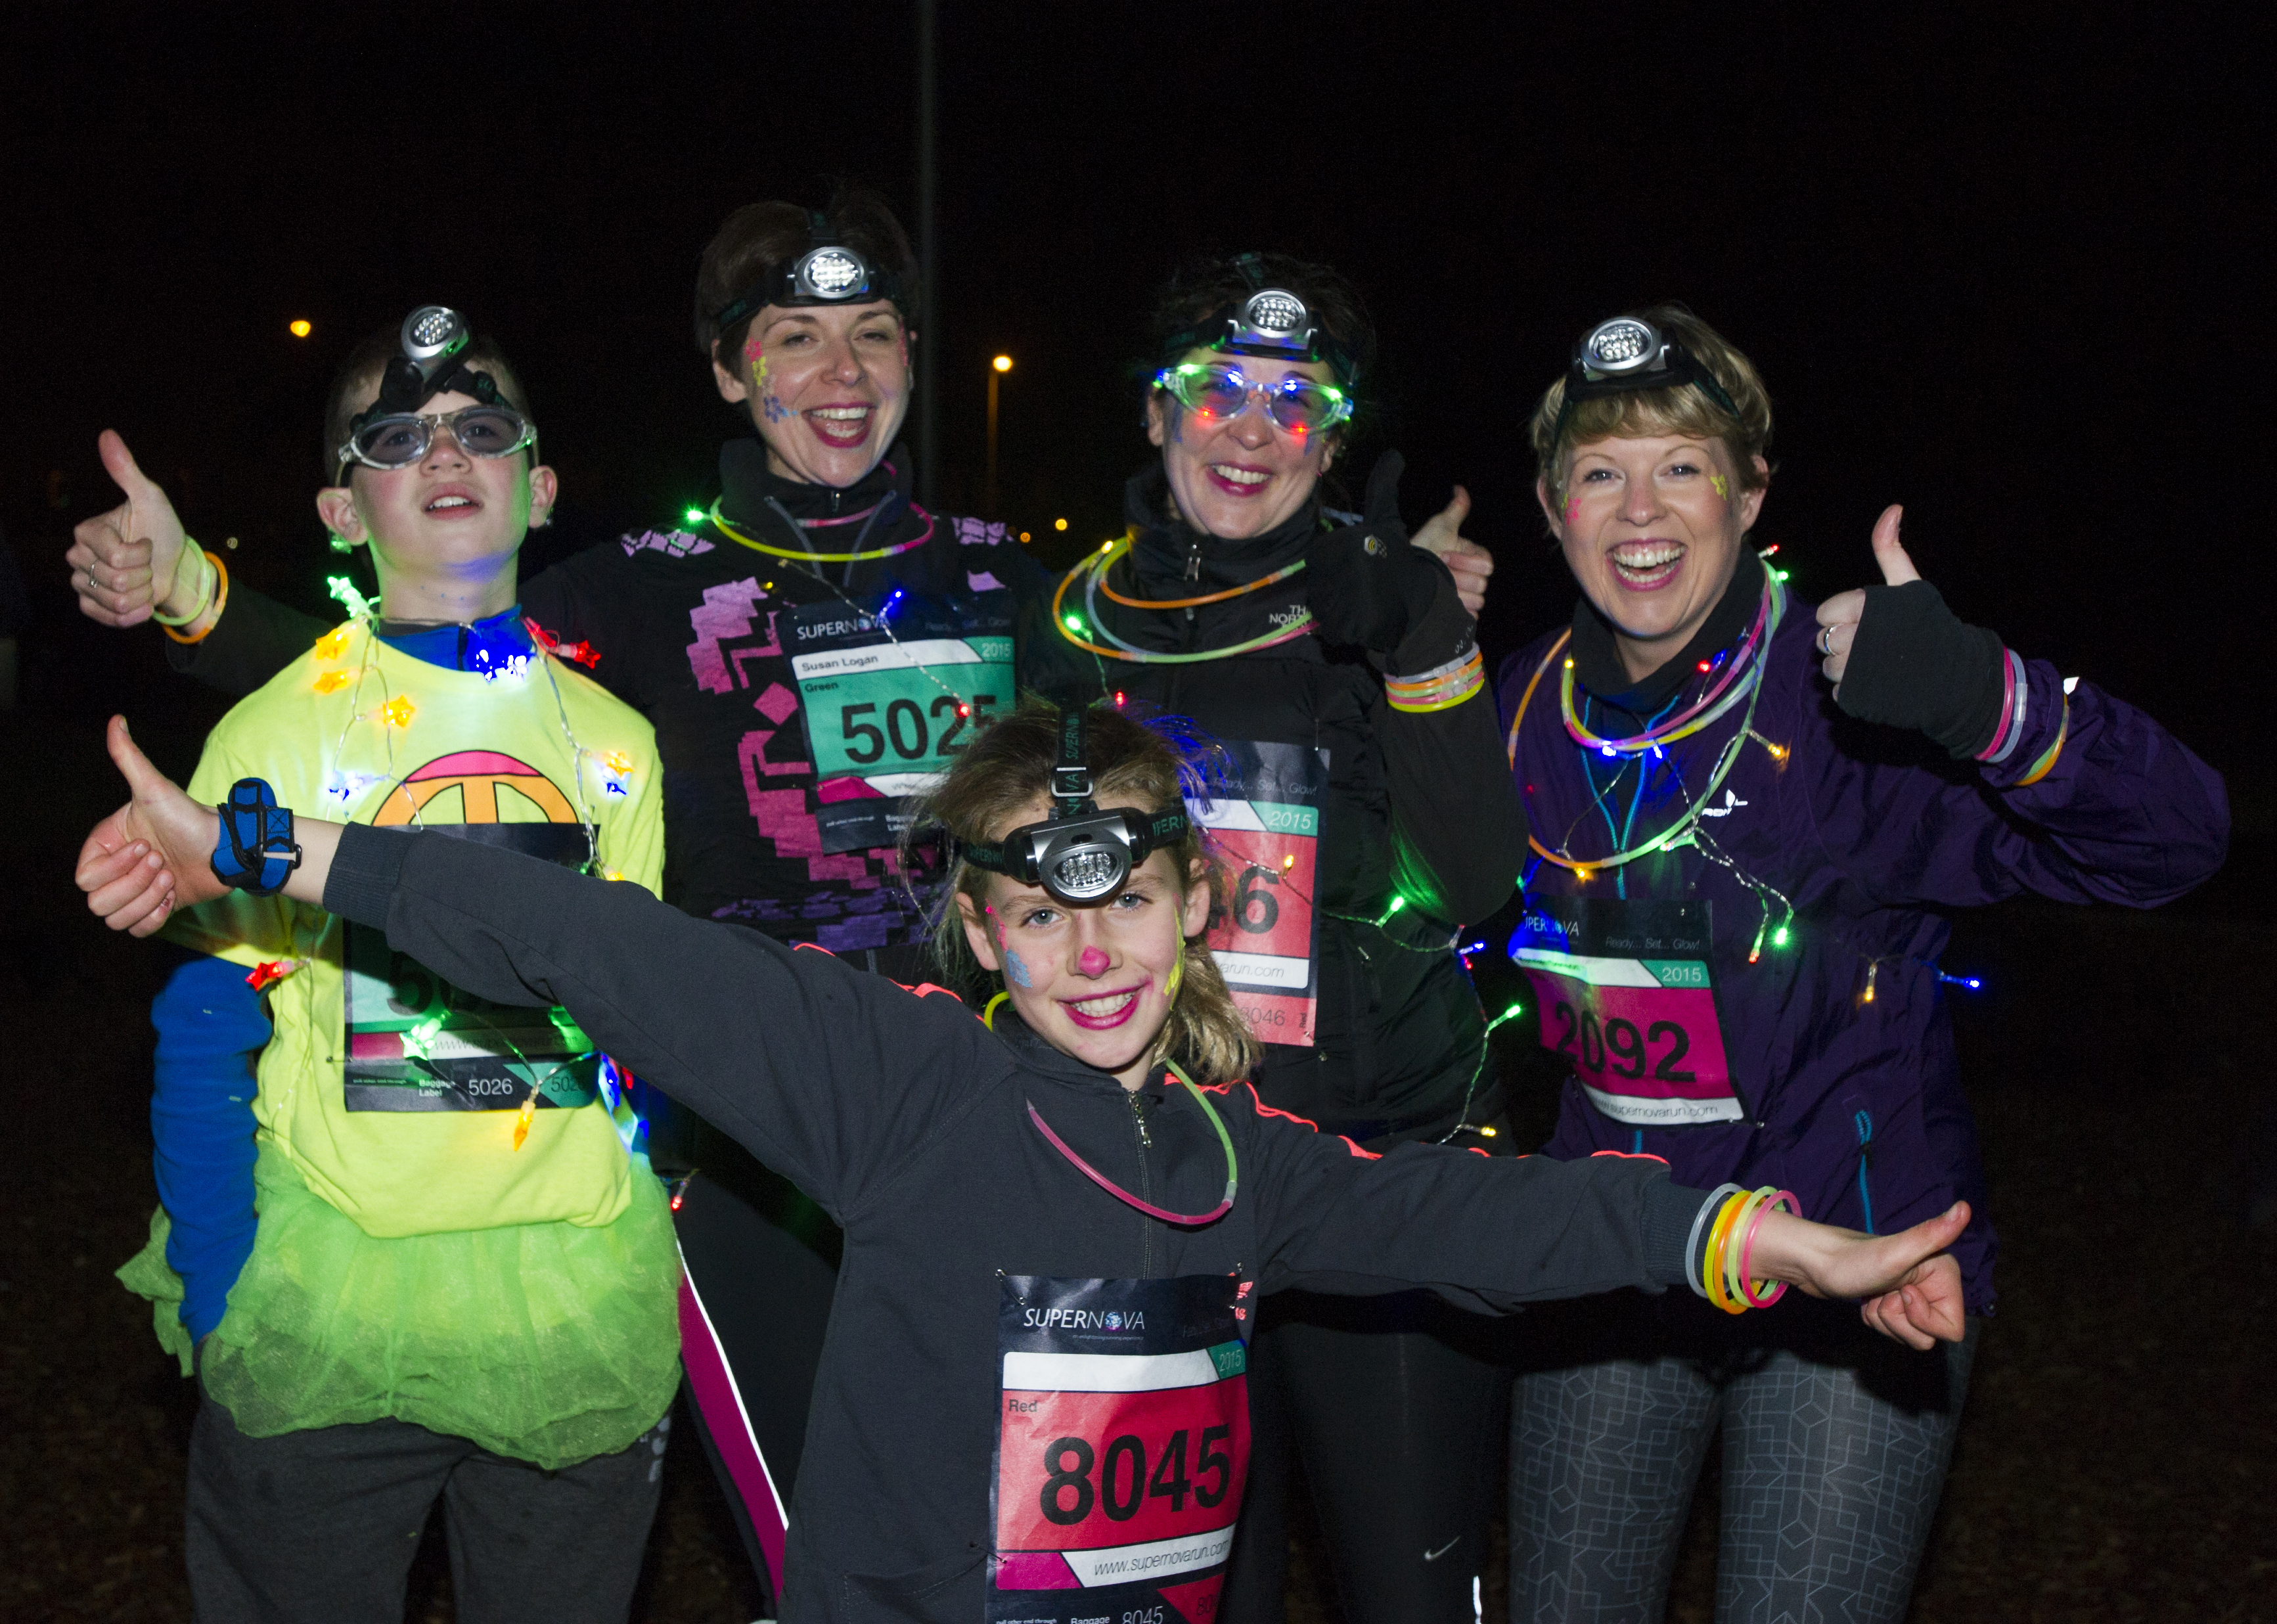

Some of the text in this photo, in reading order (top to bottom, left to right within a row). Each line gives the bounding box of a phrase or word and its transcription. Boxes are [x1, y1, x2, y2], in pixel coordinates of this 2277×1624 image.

[982, 643, 1012, 658] 2015
[802, 656, 878, 671] Susan Logan
[804, 682, 839, 692] Green
[1269, 810, 1312, 830] 2015
[1662, 967, 1702, 982] 2015
[1556, 1001, 1697, 1083] 2092
[418, 1088, 443, 1097] Label
[468, 1077, 513, 1096] 5026
[1024, 1308, 1145, 1330] SUPERNOVA
[1219, 1349, 1242, 1372] 2015
[1008, 1399, 1038, 1413] Red
[1040, 1424, 1232, 1525] 8045
[1094, 1540, 1229, 1576] www.supernovarun.com
[1122, 1606, 1163, 1624] 8045
